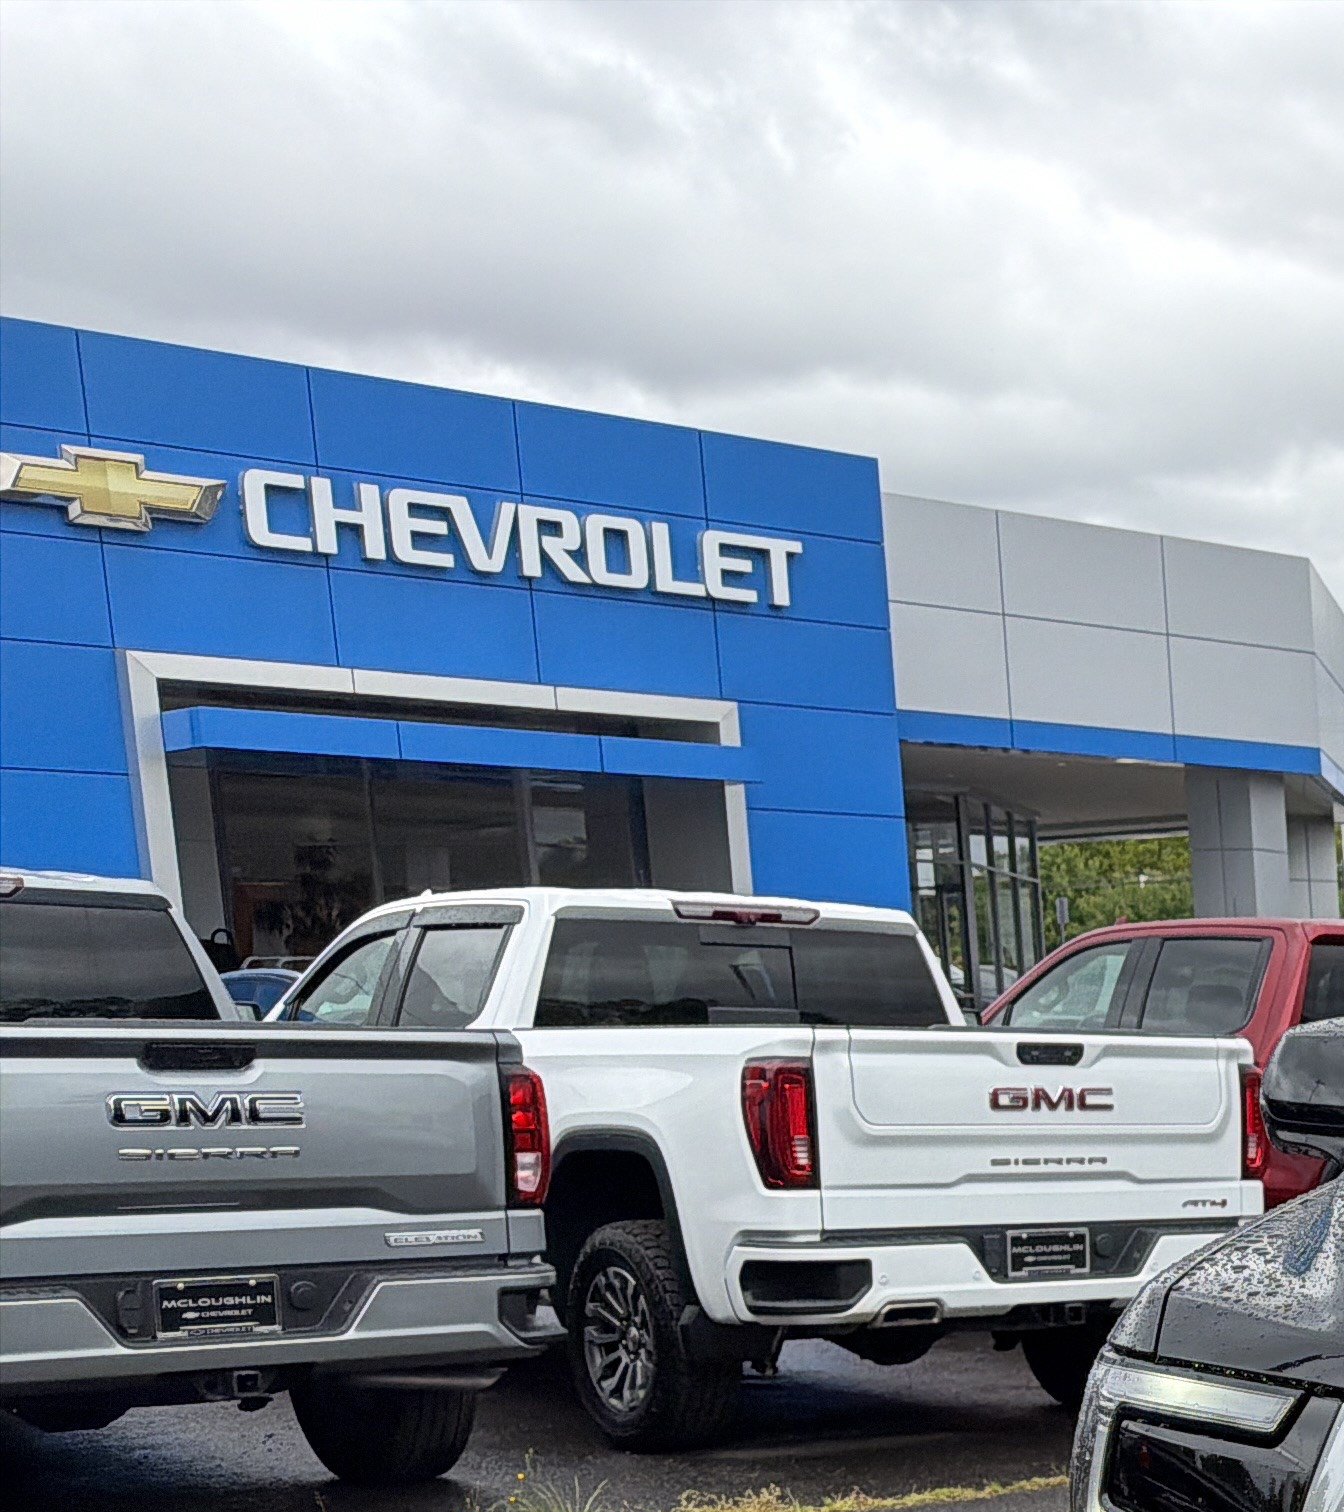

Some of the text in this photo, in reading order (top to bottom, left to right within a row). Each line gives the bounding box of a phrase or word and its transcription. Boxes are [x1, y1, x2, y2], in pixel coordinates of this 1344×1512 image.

[242, 467, 803, 608] CHEVROLET
[988, 1086, 1115, 1112] GMC
[106, 1091, 306, 1131] GMC
[1182, 1198, 1228, 1209] AT4
[161, 1294, 273, 1309] MCLOUGHLIN
[201, 1308, 254, 1319] CHEVROLET
